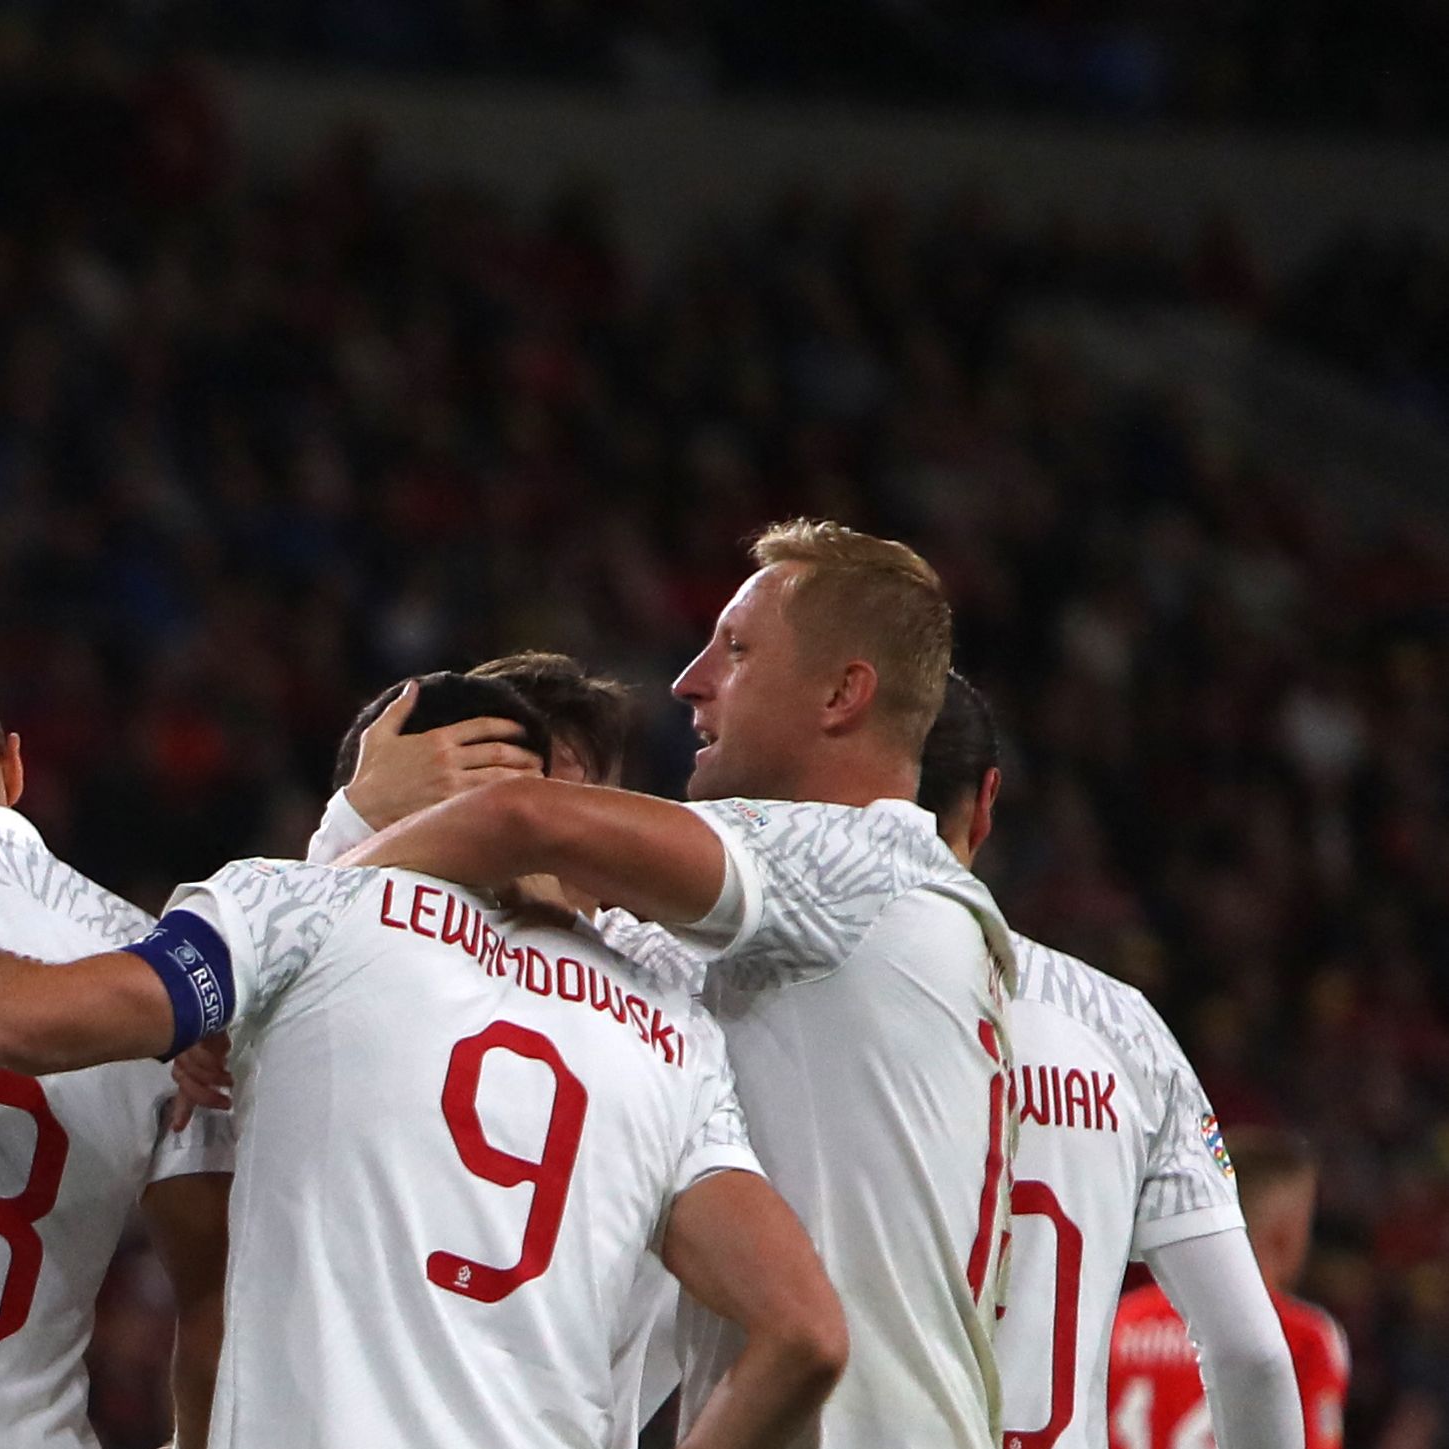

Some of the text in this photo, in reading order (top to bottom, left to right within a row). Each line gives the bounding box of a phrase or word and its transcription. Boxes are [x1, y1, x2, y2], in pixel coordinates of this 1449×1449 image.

[191, 967, 221, 1031] RESPE
[1018, 1064, 1119, 1133] WIAK
[426, 1020, 589, 1304] 9
